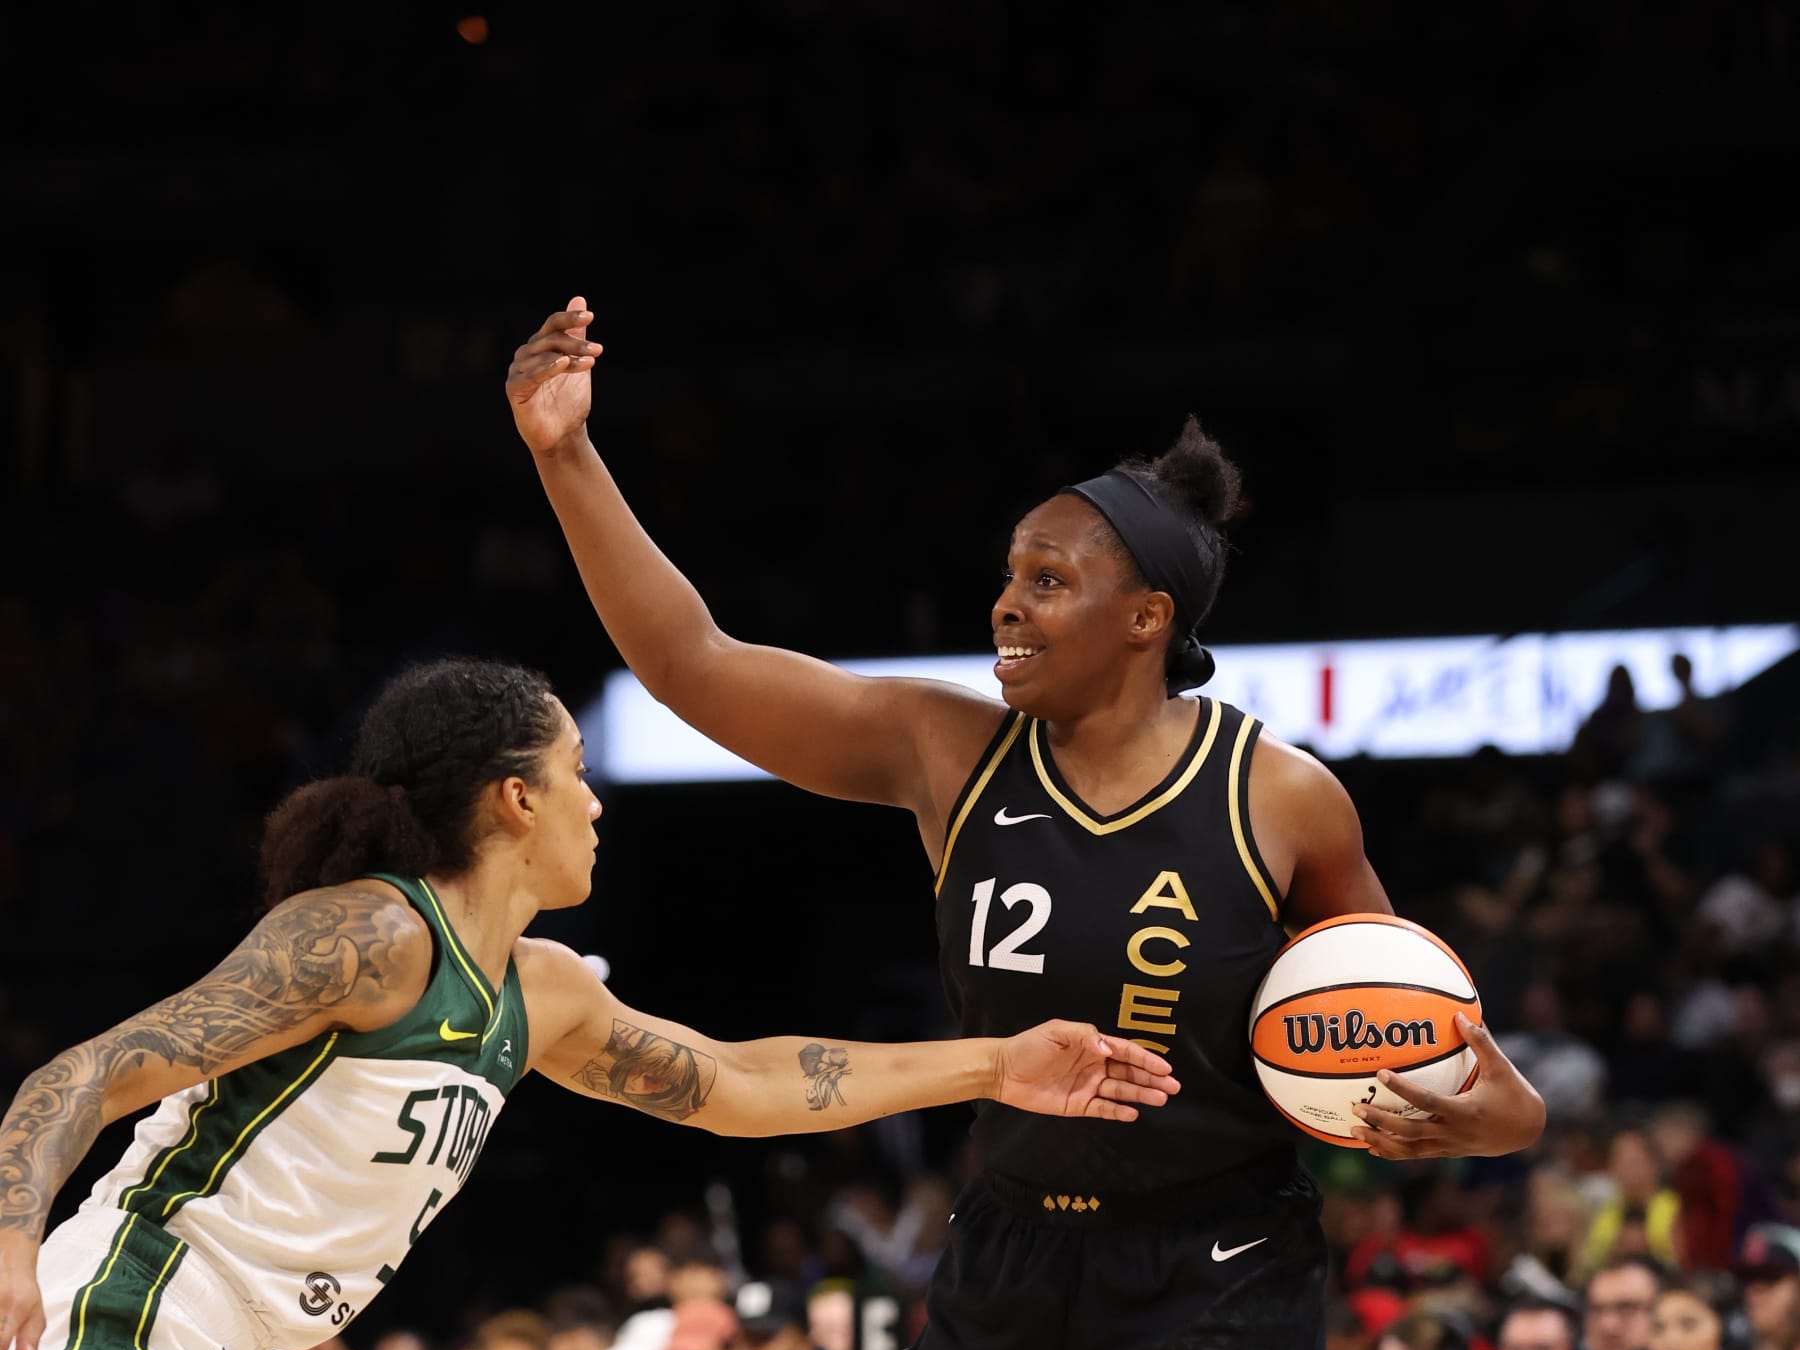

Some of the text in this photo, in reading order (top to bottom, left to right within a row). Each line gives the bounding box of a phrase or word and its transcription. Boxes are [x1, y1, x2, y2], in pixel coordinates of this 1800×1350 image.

[968, 876, 1052, 974] 12
[1117, 870, 1199, 1055] ACE
[1282, 1009, 1437, 1054] Wilson
[1303, 1104, 1339, 1116] OFFICIAL
